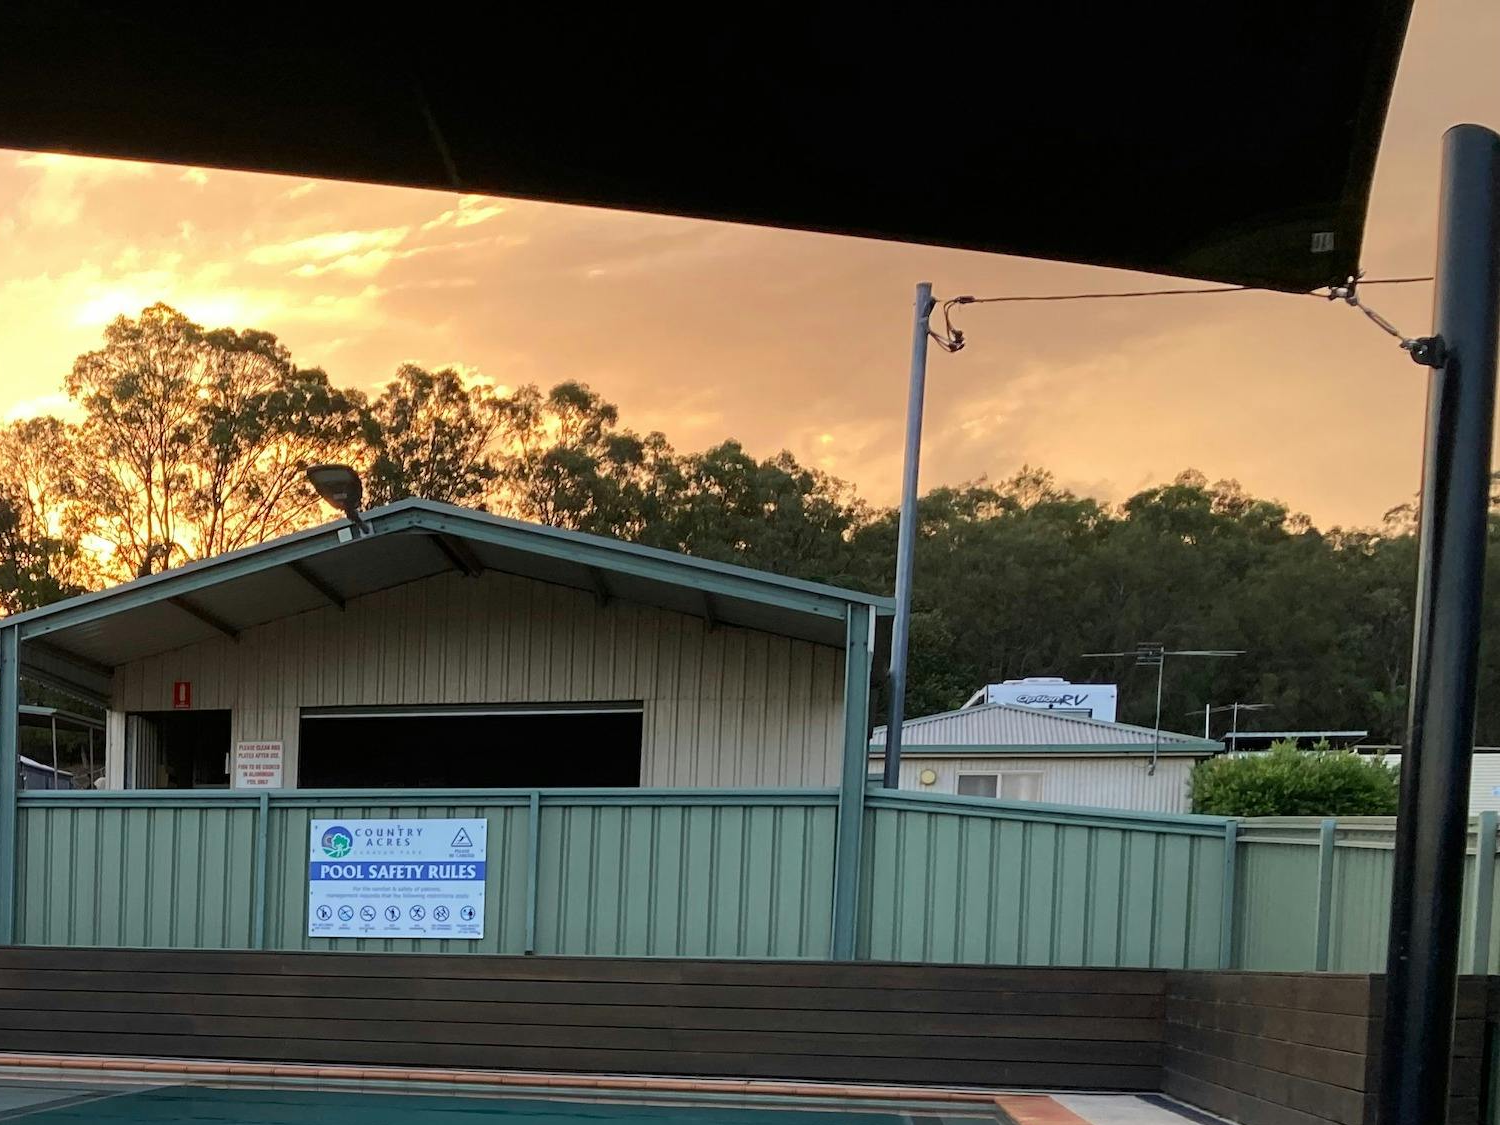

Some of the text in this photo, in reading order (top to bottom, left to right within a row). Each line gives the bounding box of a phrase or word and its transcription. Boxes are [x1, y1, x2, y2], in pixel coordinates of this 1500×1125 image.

[355, 828, 423, 837] COUNTRY
[366, 838, 411, 847] ACRES
[320, 864, 476, 879] POOL SAFETY RULES
